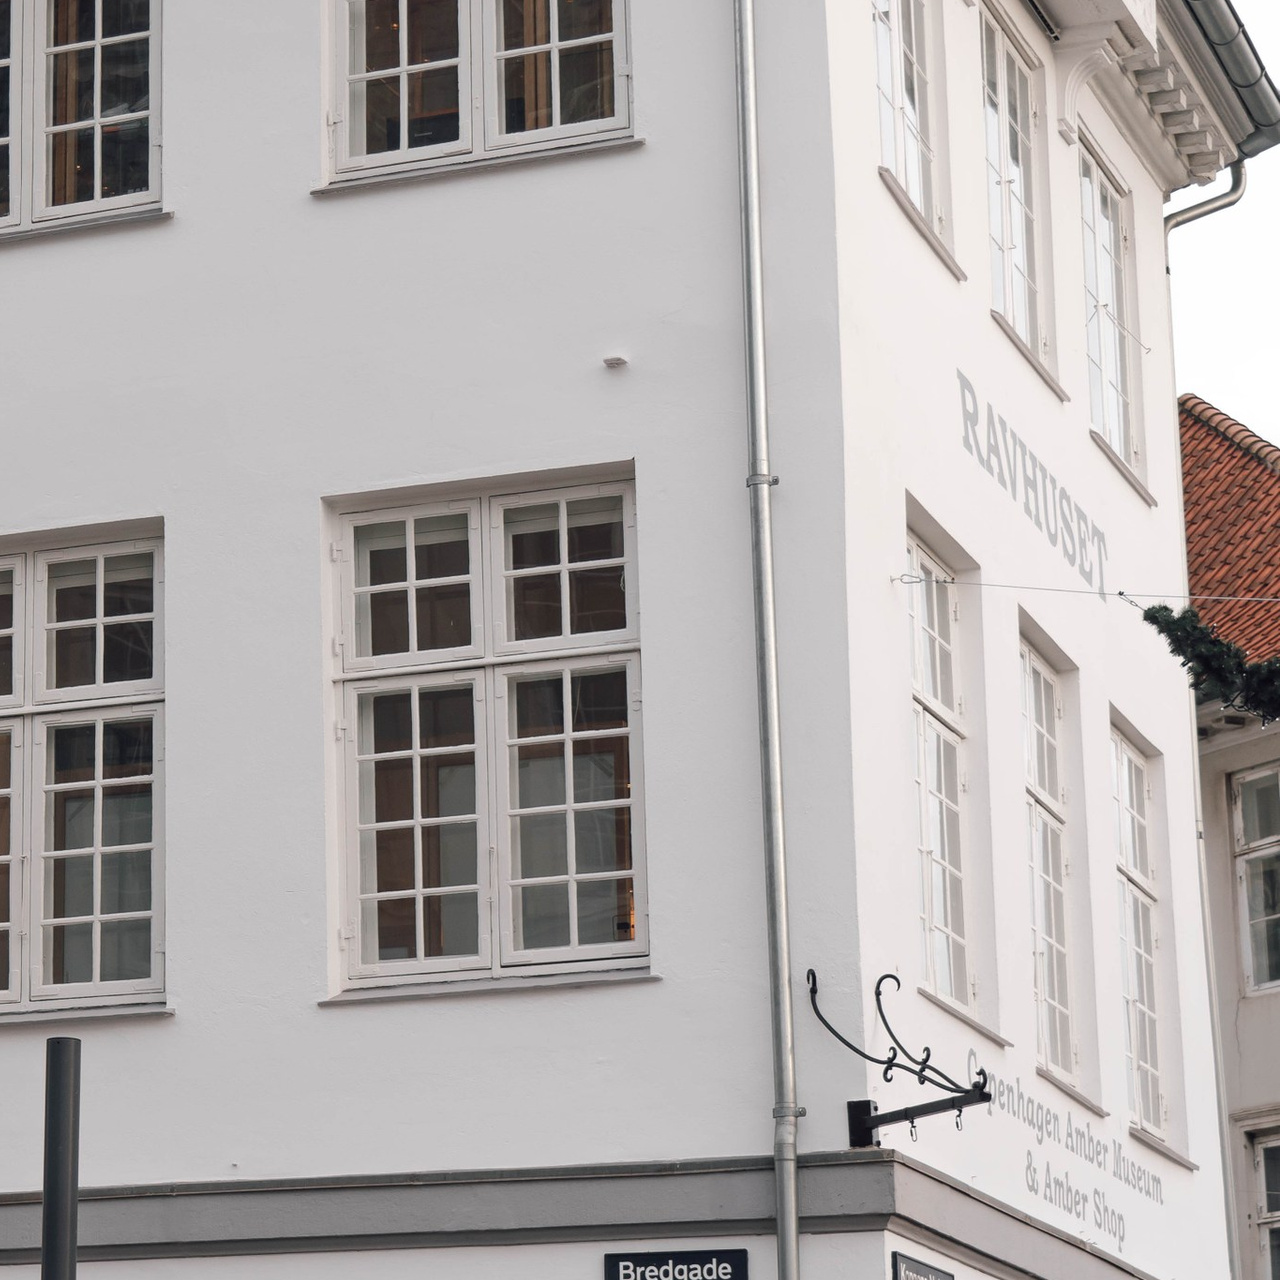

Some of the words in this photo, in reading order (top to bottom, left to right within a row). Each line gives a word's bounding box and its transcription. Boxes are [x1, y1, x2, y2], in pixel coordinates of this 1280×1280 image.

[956, 367, 1108, 602] RAVHUSET
[966, 1047, 1061, 1145] Cpenhagen
[1065, 1111, 1109, 1171] Amber
[1112, 1138, 1164, 1206] Museum
[1026, 1149, 1039, 1196] &
[1043, 1161, 1088, 1221] Amber
[1093, 1187, 1125, 1253] Shop
